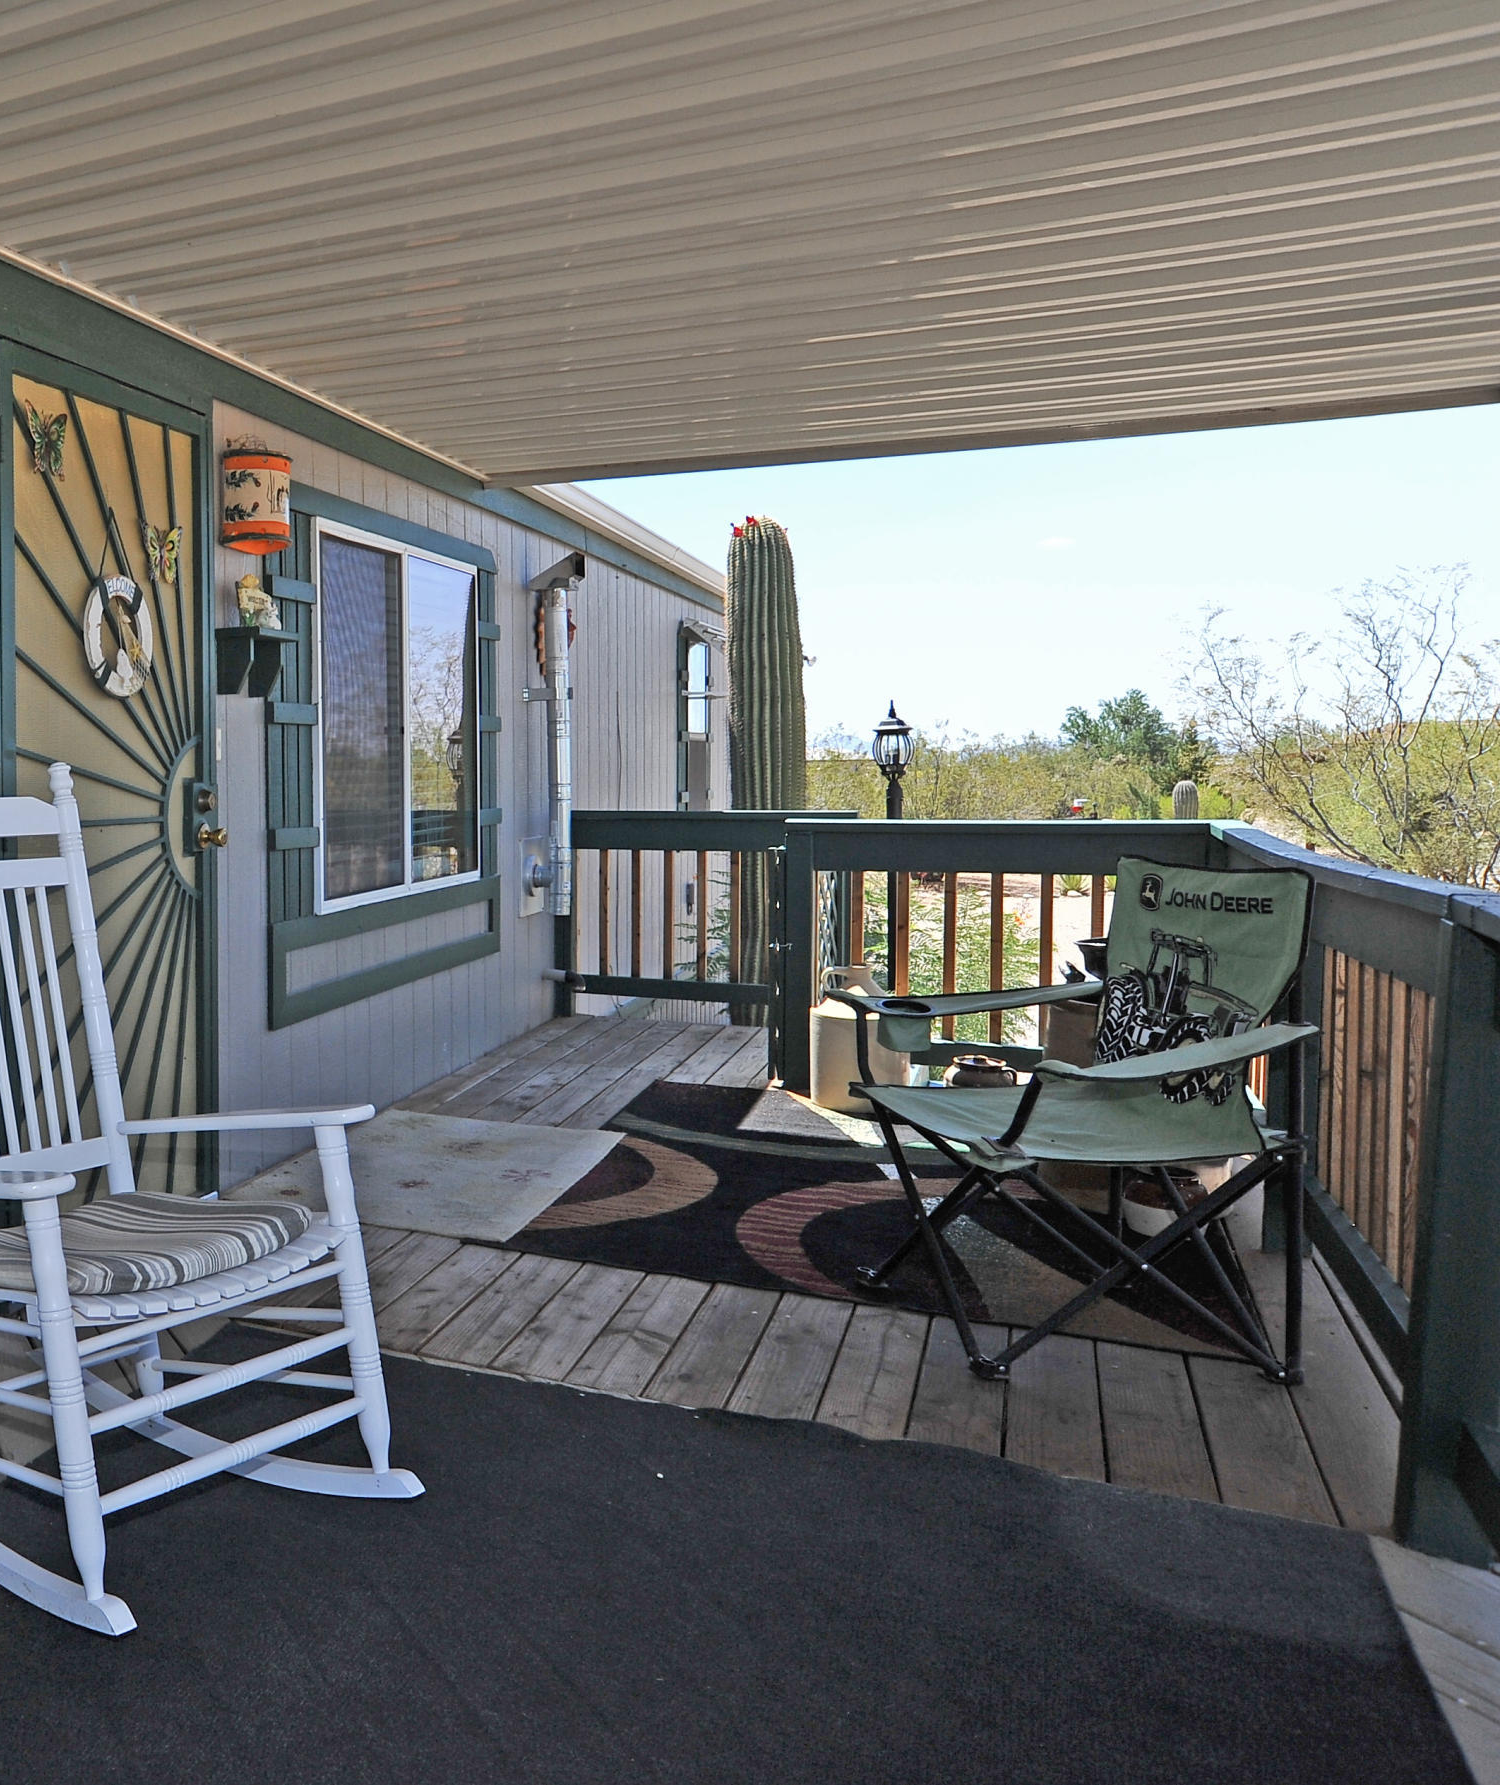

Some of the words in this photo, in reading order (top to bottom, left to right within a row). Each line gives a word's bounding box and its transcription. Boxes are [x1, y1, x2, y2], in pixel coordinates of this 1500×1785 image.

[107, 577, 136, 600] ELCOME
[1165, 887, 1208, 911] JOHN
[1210, 891, 1274, 914] DEERE
